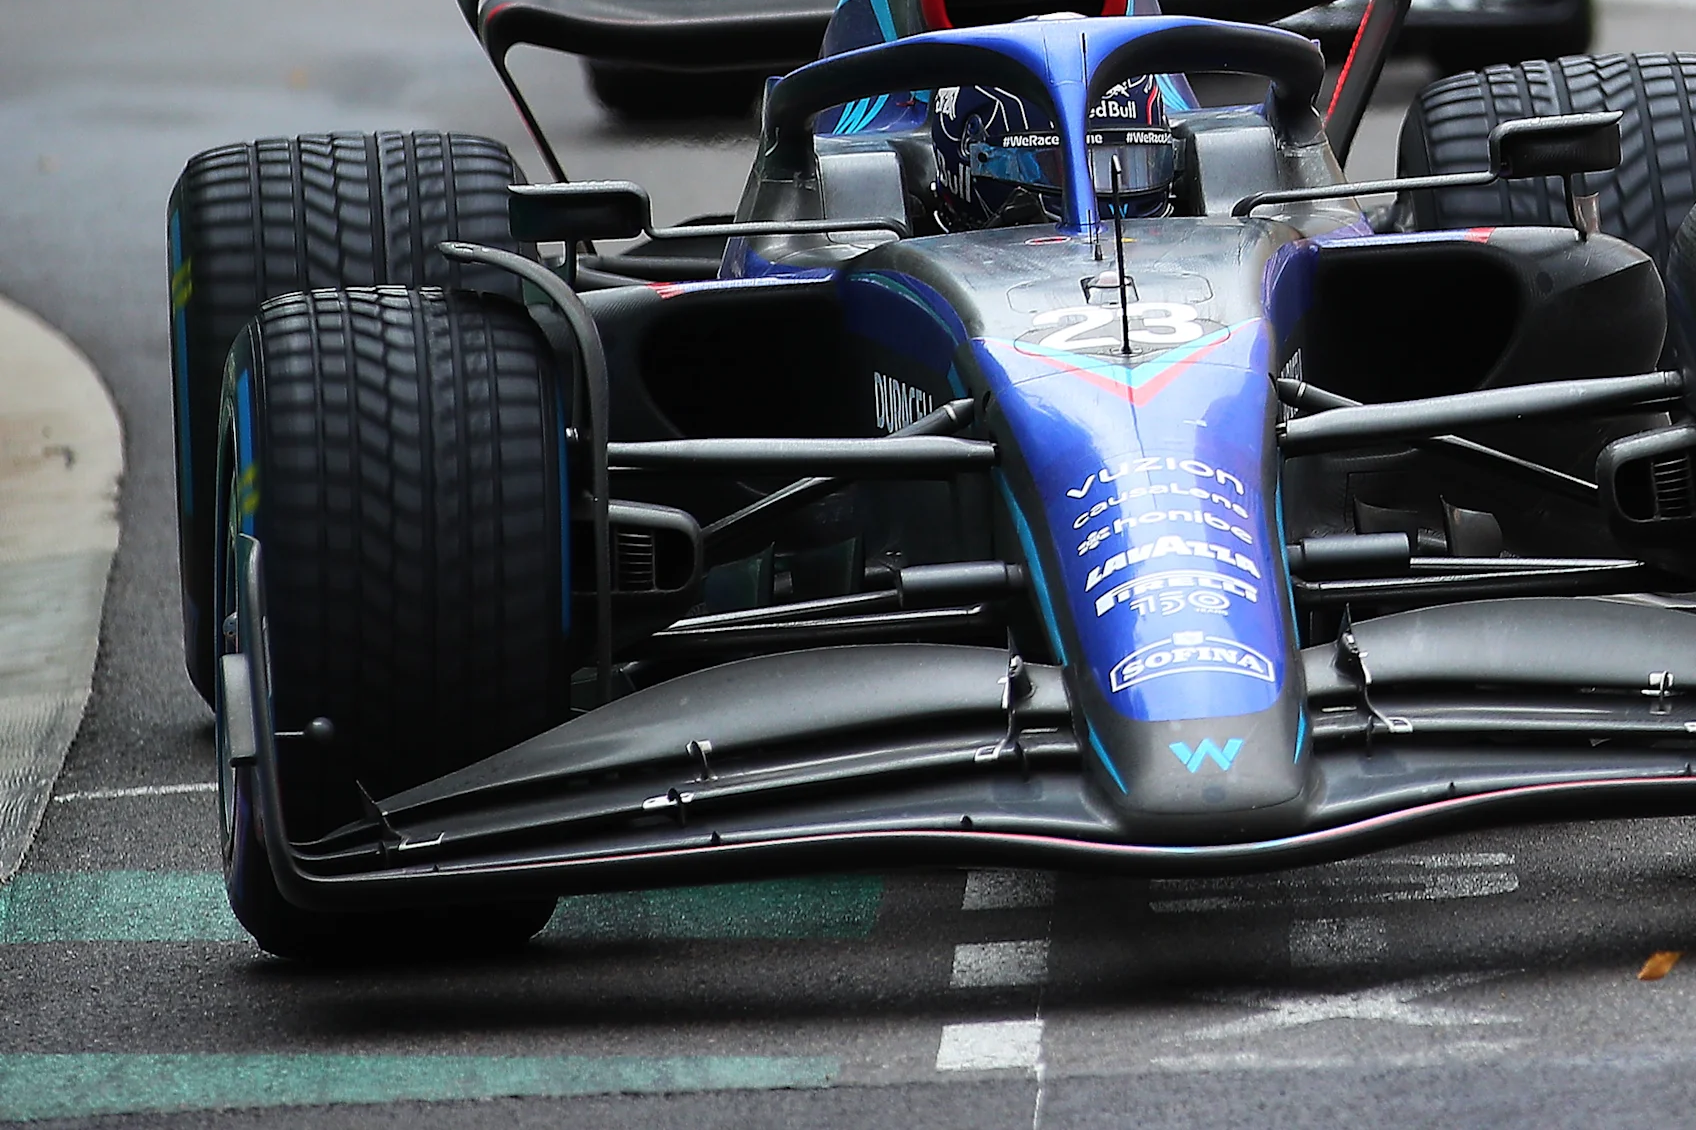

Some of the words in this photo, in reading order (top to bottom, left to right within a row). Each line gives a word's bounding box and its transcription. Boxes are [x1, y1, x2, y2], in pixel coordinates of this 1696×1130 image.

[1088, 100, 1107, 119] ed
[1108, 100, 1137, 119] Bull
[1032, 302, 1205, 352] 23
[1083, 534, 1262, 593] LAVAZZA
[1094, 569, 1259, 618] PIRELLI
[1120, 646, 1266, 683] SOFINA
